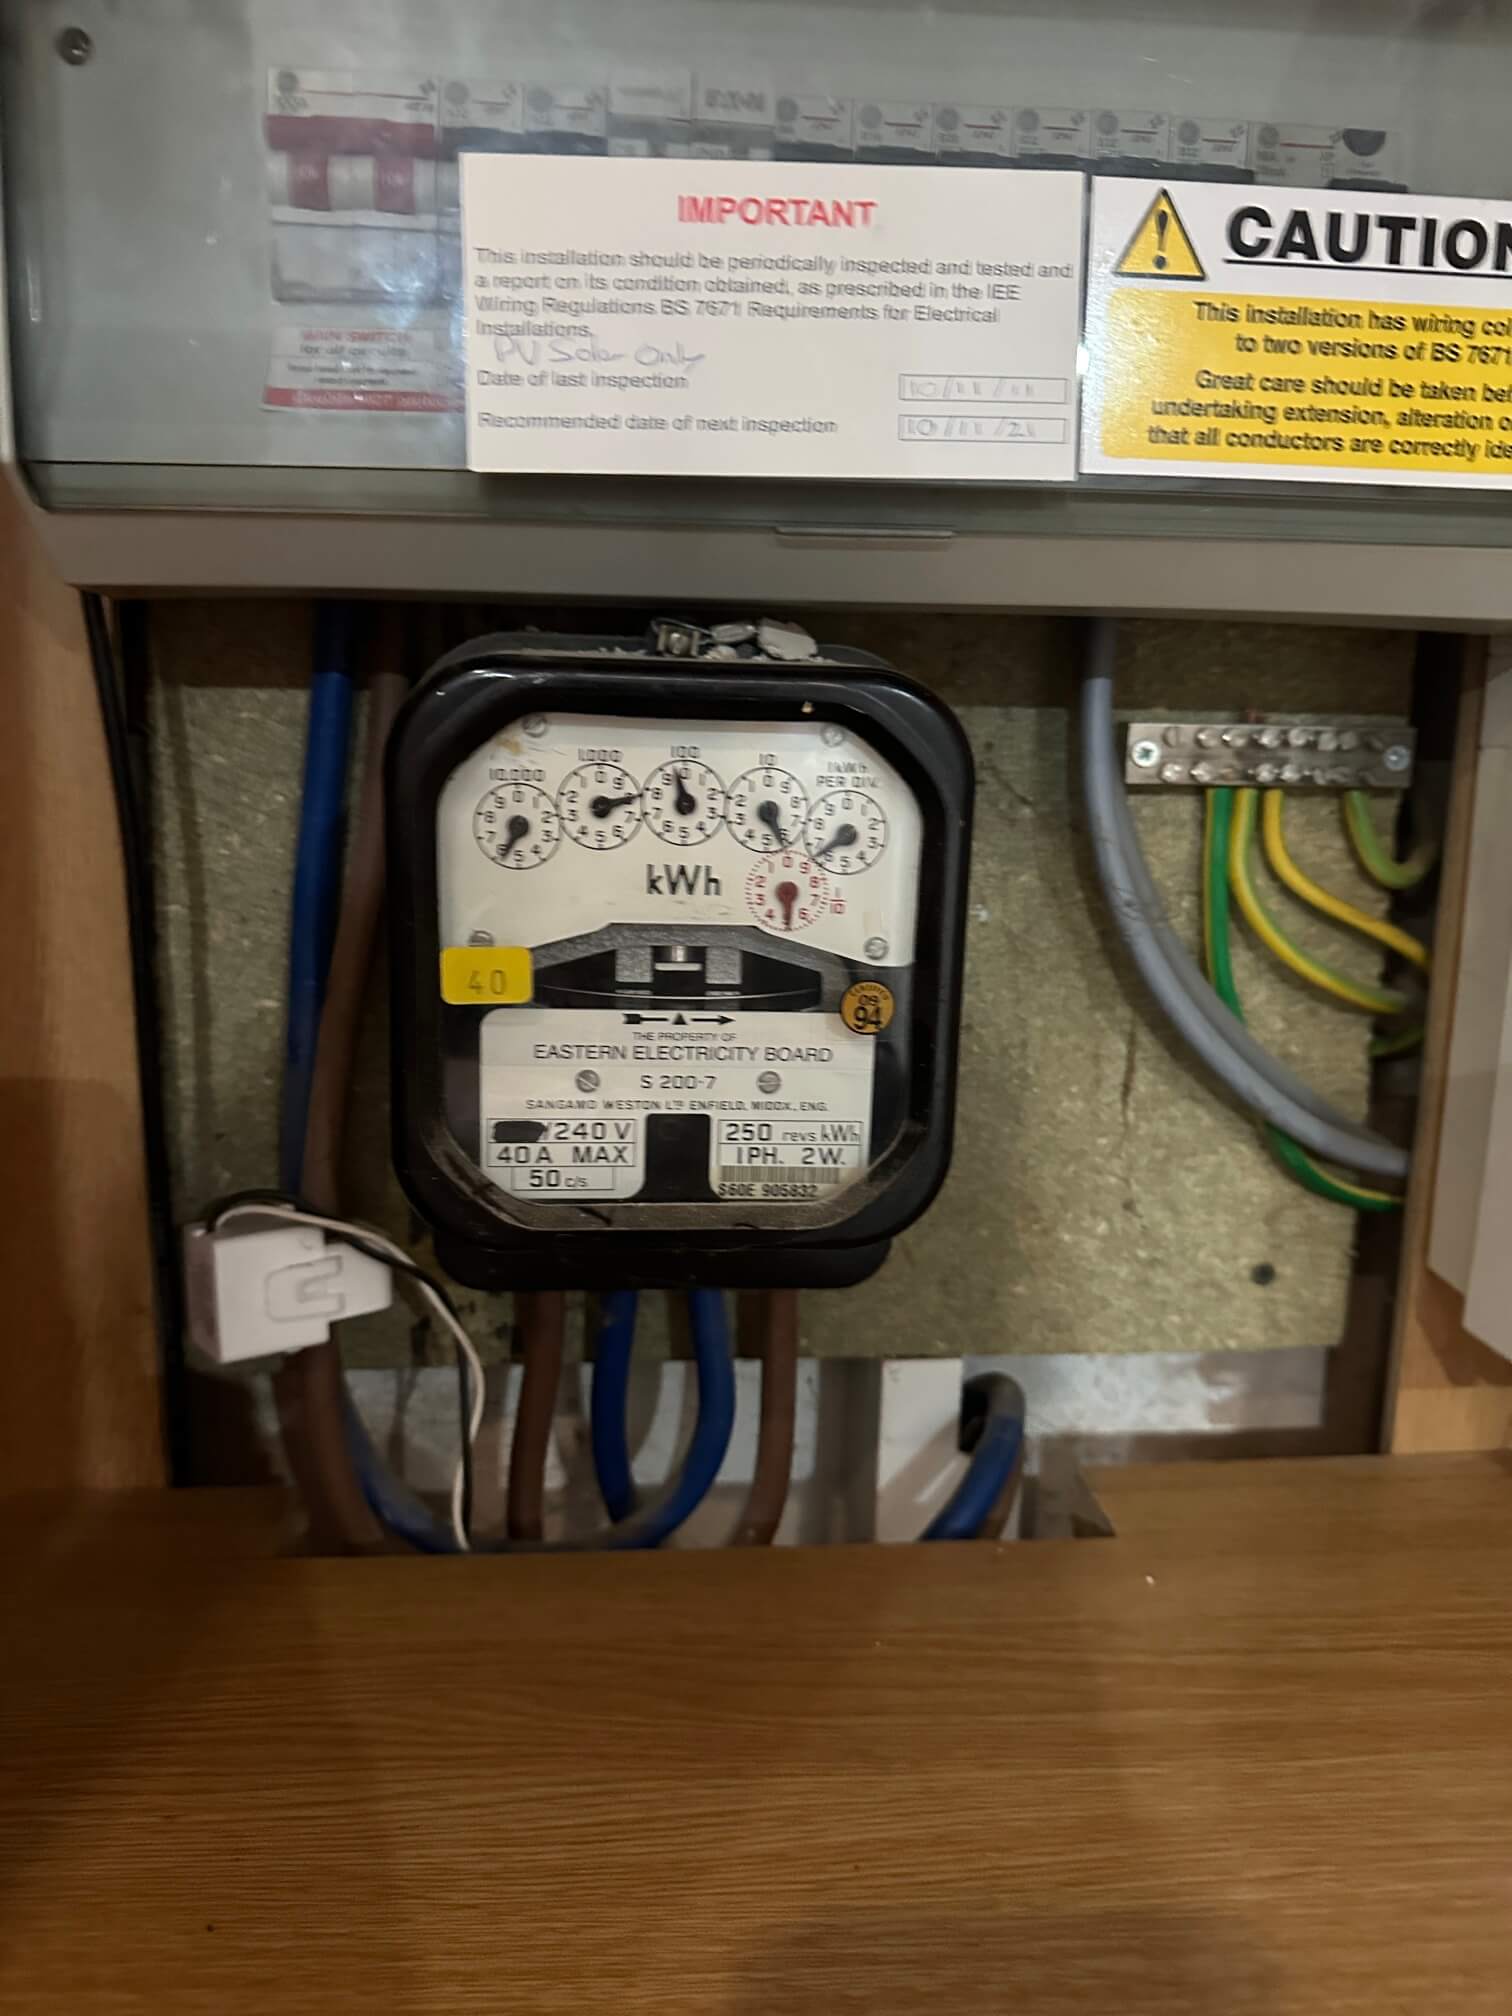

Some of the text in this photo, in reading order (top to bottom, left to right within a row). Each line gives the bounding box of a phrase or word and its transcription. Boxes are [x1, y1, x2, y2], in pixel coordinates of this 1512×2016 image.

[677, 195, 878, 228] IMPORTANT
[474, 247, 1074, 279] This installation should be periodically inspected and tested and
[474, 273, 1021, 302] a report on its condition obtained, as prescribed in the IEE
[475, 295, 1000, 324] Wiring Regulations BS 7671 Requirements for Electrical
[1193, 301, 1240, 323] This
[1246, 303, 1363, 329] installation
[1368, 309, 1406, 331] has
[1411, 314, 1475, 337] wiring
[476, 319, 594, 338] Installations.
[493, 337, 537, 365] PV
[634, 340, 706, 373] Only
[1235, 333, 1257, 353] to
[1262, 334, 1301, 355] two
[1307, 339, 1397, 359] versions
[1402, 341, 1425, 361] of
[1430, 343, 1462, 363] BS
[477, 369, 689, 391] Date of last inspection
[1195, 368, 1254, 392] Great
[1259, 374, 1305, 393] care
[1311, 374, 1383, 398] should
[1388, 378, 1415, 398] be
[1420, 380, 1477, 402] taken
[478, 411, 838, 437] Recommended date of next inspection
[1152, 399, 1277, 424] undertaking
[1284, 405, 1391, 429] extension,
[1396, 407, 1492, 431] alteration
[1148, 424, 1189, 446] that
[1194, 425, 1220, 446] all
[1225, 430, 1344, 452] conductors
[1349, 438, 1382, 454] are
[1388, 438, 1477, 463] correctly
[671, 745, 700, 758] 100
[759, 753, 778, 767] 10
[816, 775, 847, 789] PER
[646, 863, 722, 896] kWh
[468, 969, 507, 996] 40
[854, 1005, 882, 1030] 94
[632, 1031, 736, 1043] THE PROPERTY OF
[533, 1044, 834, 1063] EASTERN ELECTRICITY BOARD
[640, 1074, 718, 1090] S 200-7
[525, 1099, 597, 1110] SANGAMO
[602, 1100, 661, 1110] WESTON
[614, 1122, 632, 1140] V
[725, 1122, 861, 1142] 250 revs kWh
[572, 1145, 629, 1164] MAX
[529, 1168, 561, 1188] 50
